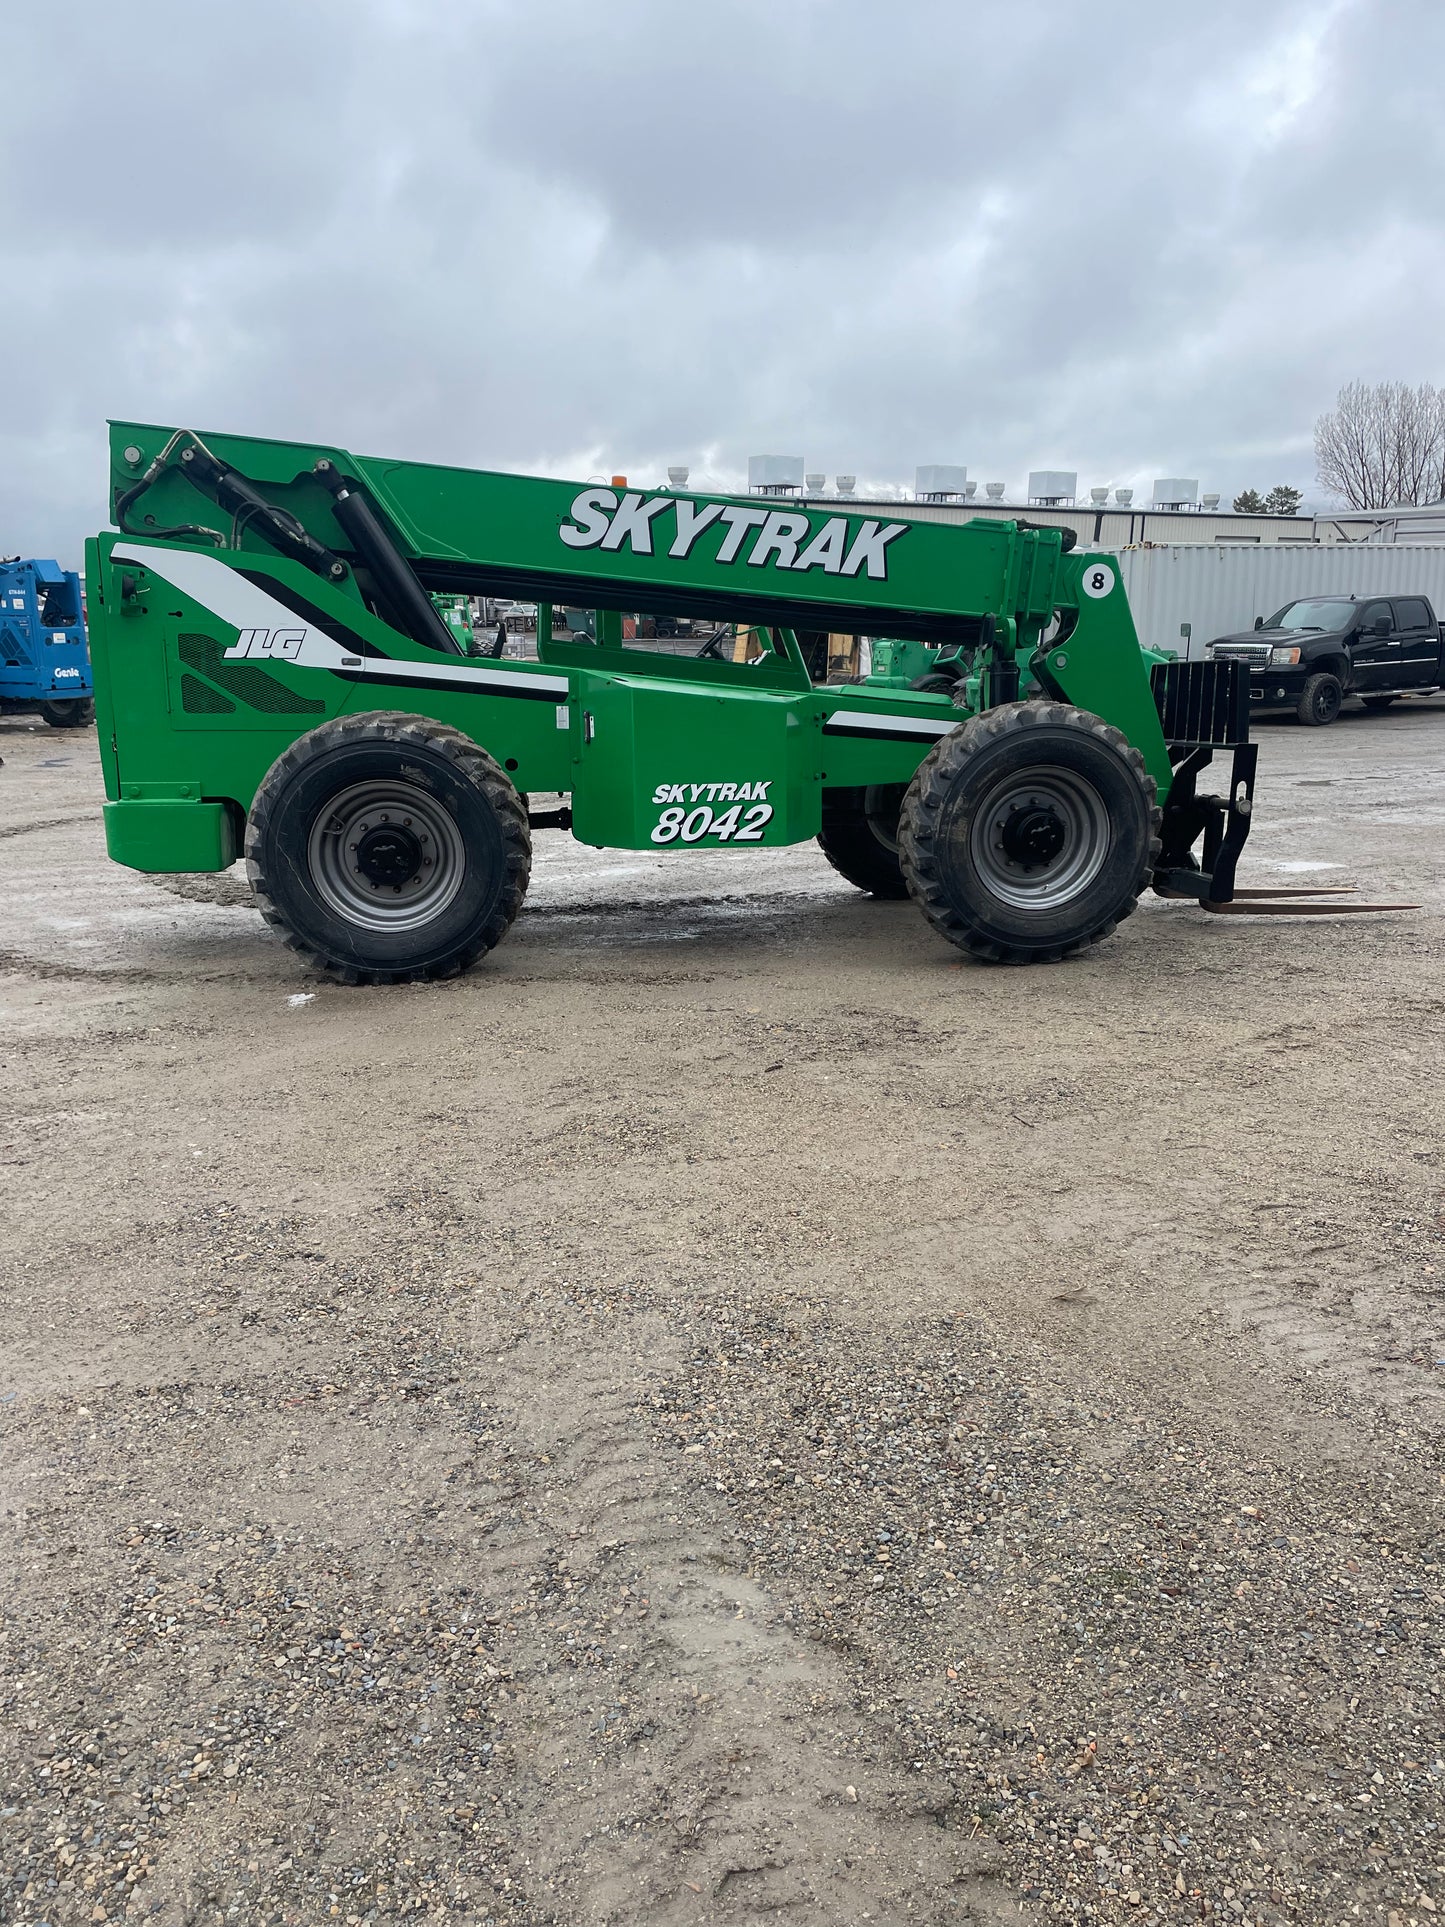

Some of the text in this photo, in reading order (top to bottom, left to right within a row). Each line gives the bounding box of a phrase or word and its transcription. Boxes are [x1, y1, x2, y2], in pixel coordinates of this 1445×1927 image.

[559, 488, 910, 580] SKYTRAK
[1091, 572, 1105, 590] 8
[223, 628, 307, 660] JLG
[54, 667, 80, 678] Genie
[652, 781, 773, 804] SKYTRAK
[650, 804, 774, 844] 8042
